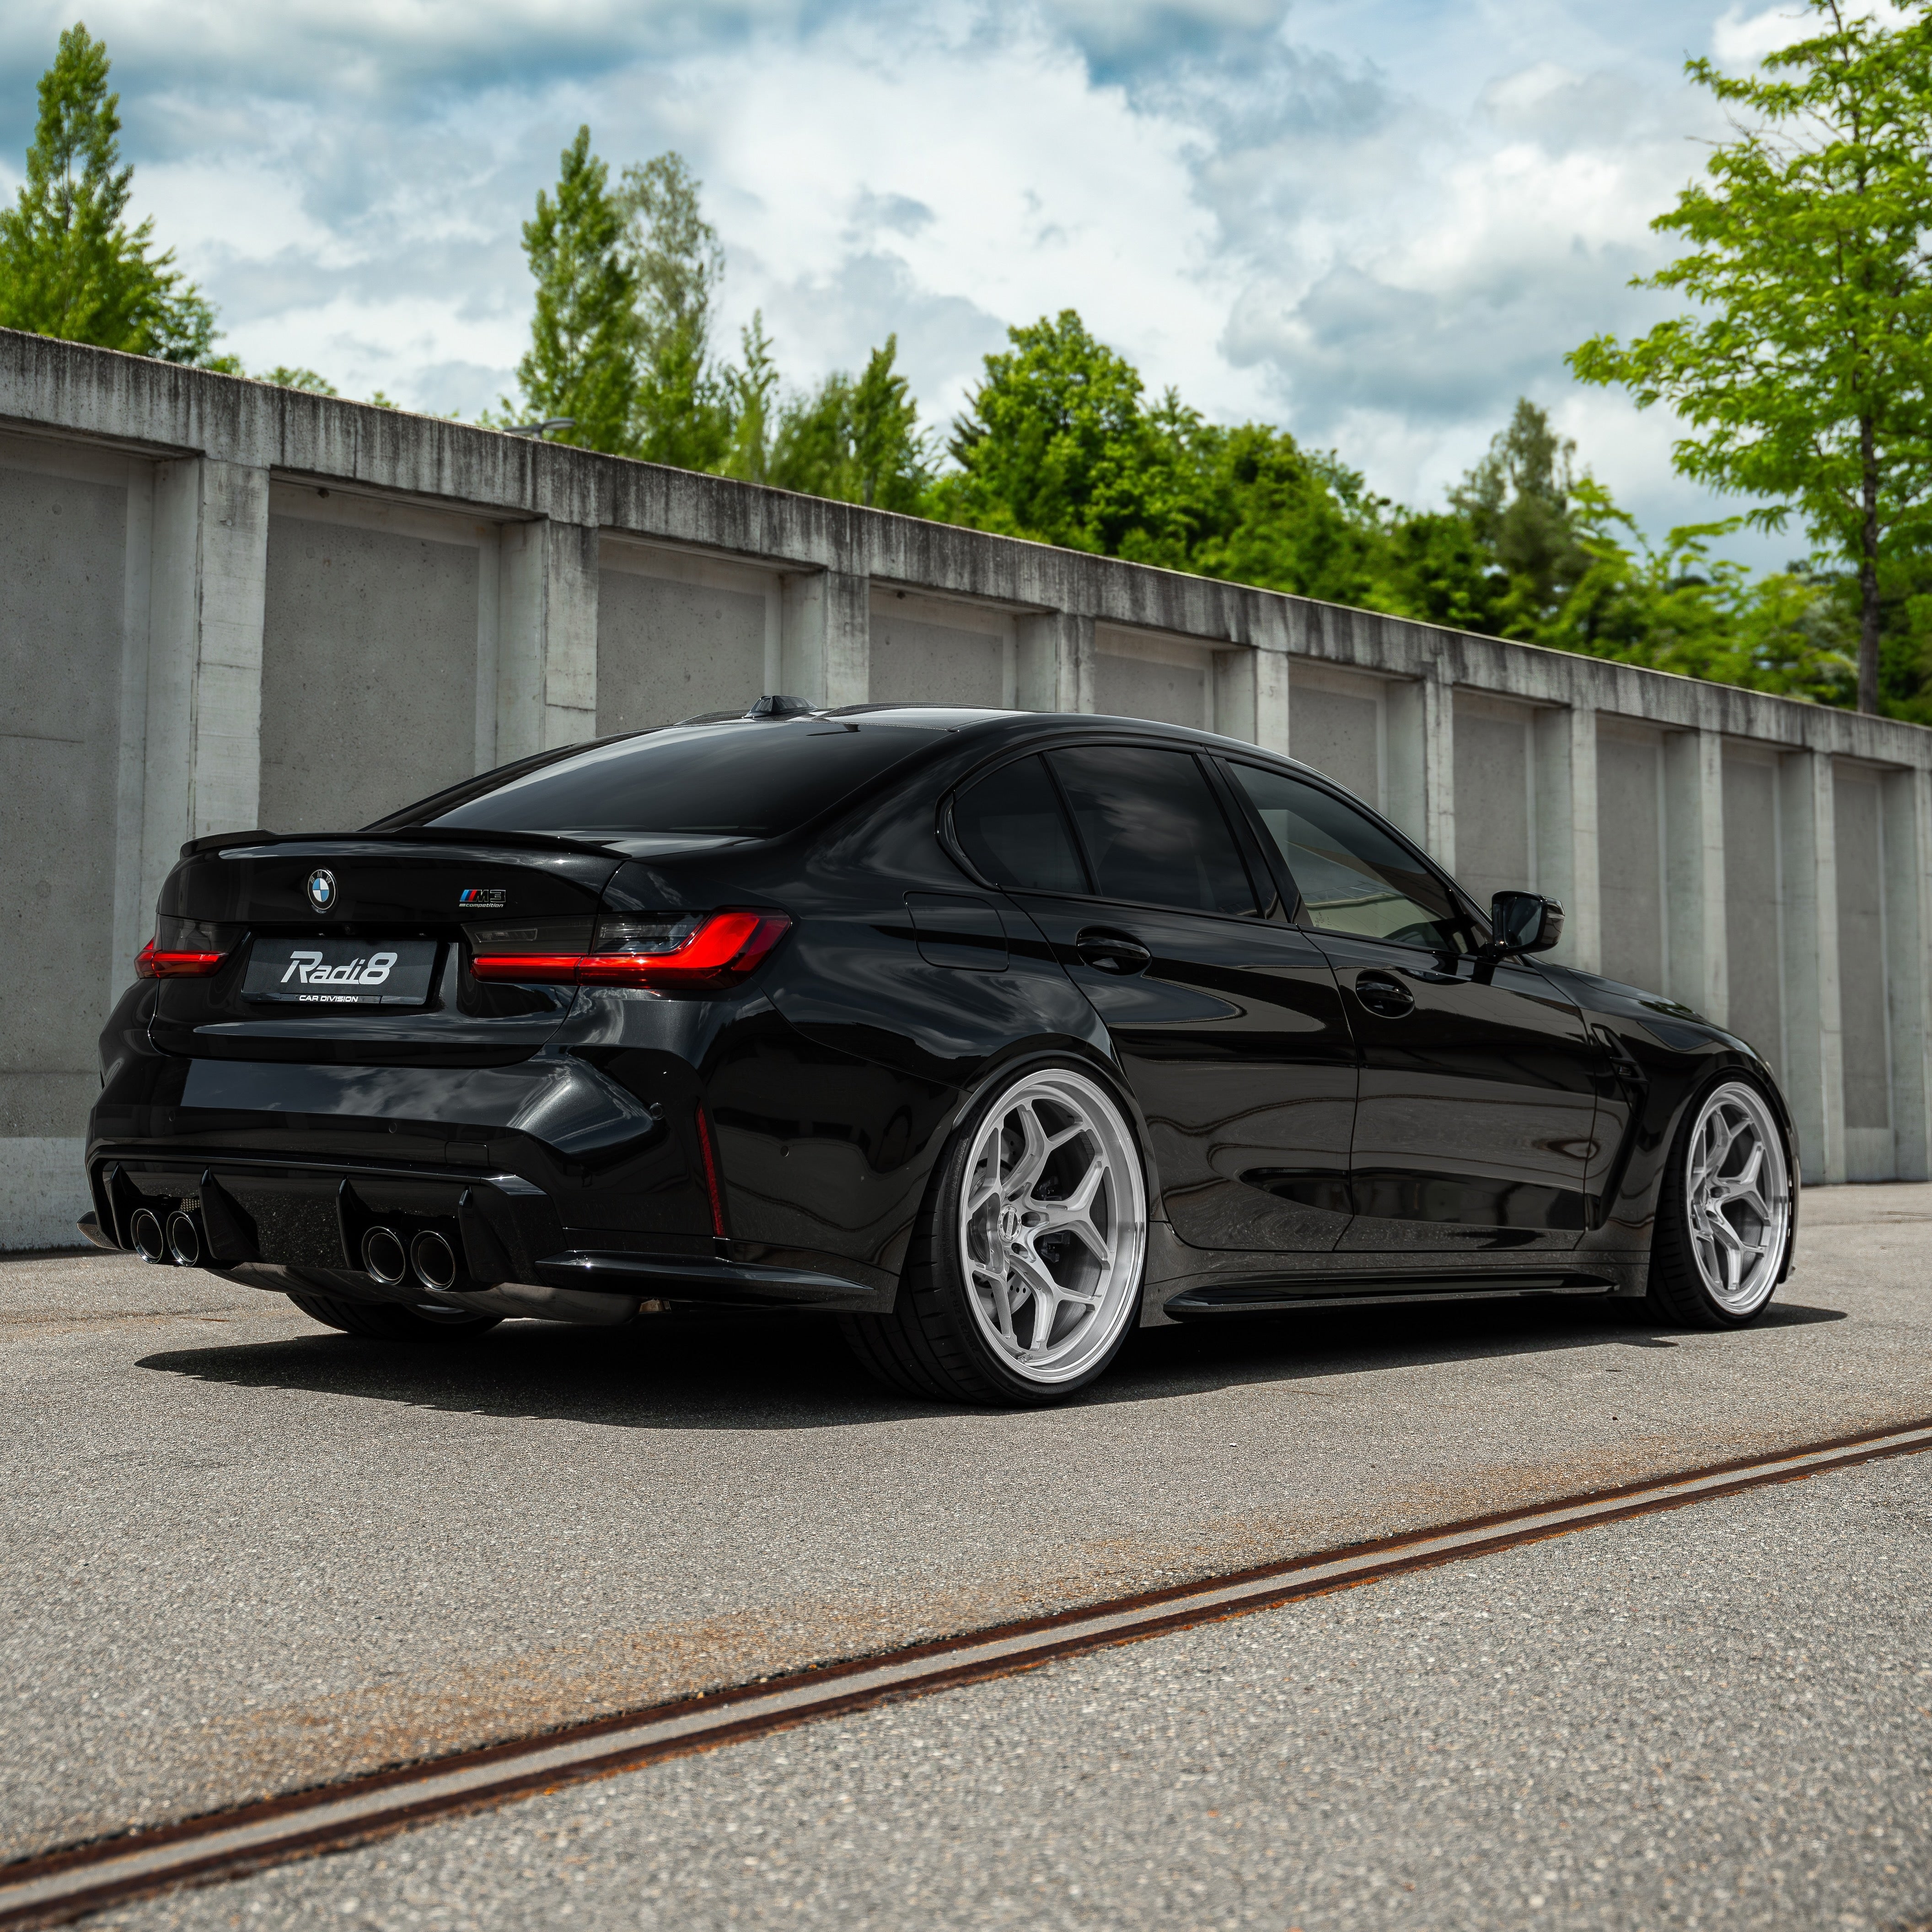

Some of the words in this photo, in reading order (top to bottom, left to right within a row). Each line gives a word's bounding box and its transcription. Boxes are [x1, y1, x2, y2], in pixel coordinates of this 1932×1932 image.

[310, 871, 332, 884] BMW
[475, 890, 506, 902] M3
[280, 951, 397, 985] Radi8
